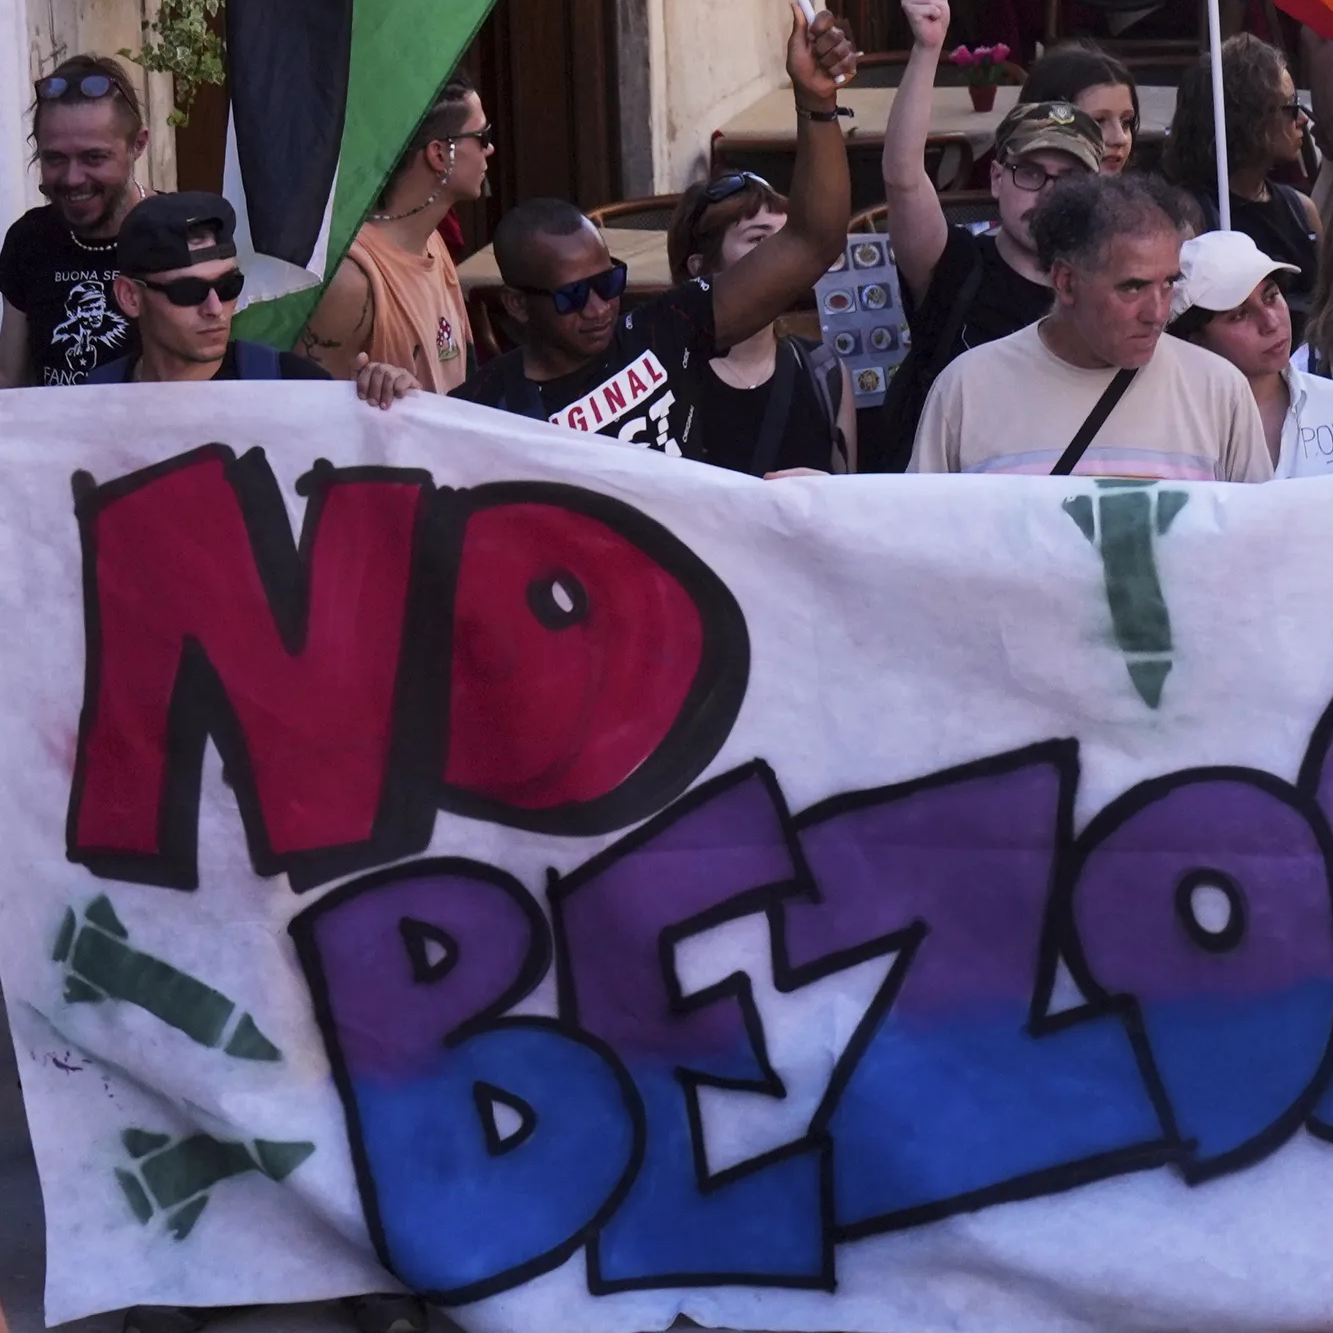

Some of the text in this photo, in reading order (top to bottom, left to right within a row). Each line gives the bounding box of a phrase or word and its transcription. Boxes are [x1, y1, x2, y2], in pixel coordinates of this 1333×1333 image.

[54, 270, 121, 282] BUONA SE
[551, 357, 663, 433] GINAL
[67, 443, 751, 891] NO
